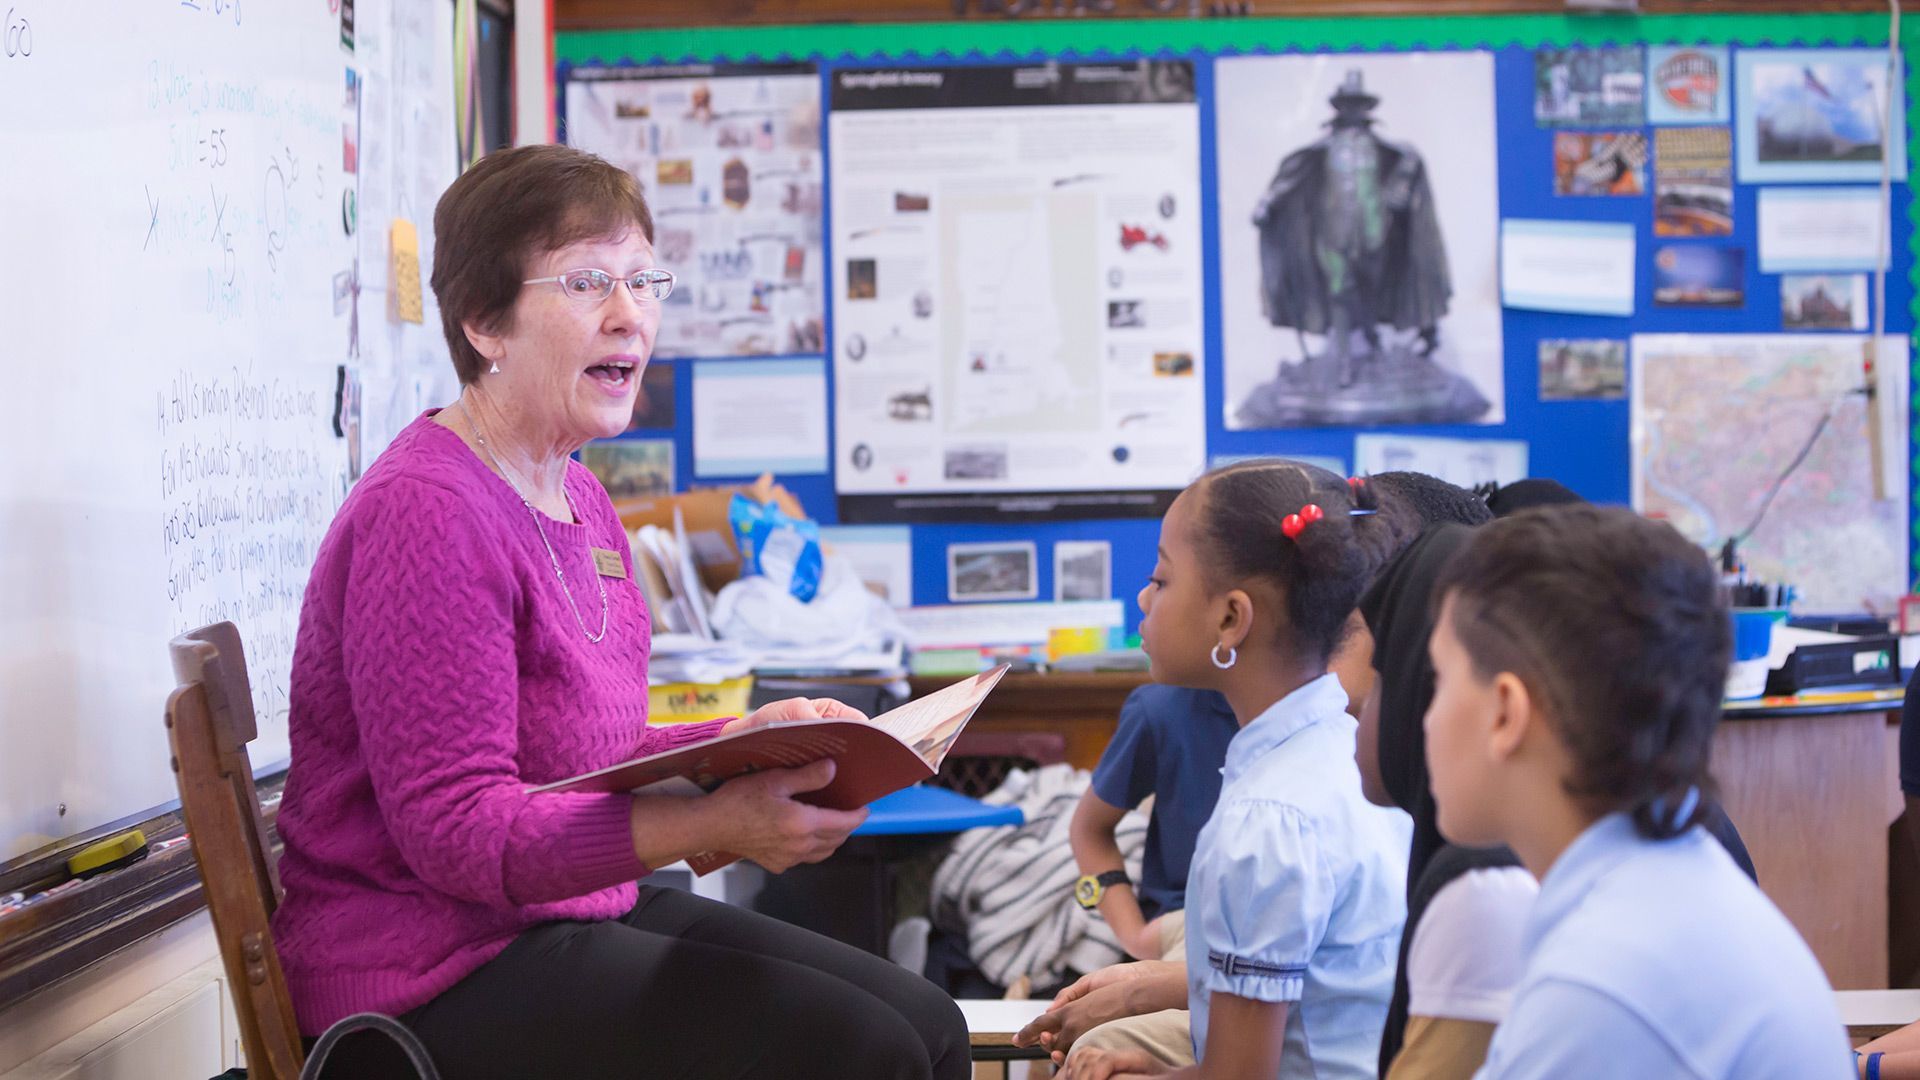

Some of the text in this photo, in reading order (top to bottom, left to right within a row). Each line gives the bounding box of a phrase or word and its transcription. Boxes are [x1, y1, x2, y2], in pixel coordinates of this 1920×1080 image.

[3, 7, 32, 57] 60
[841, 70, 944, 89] Springfield Armory
